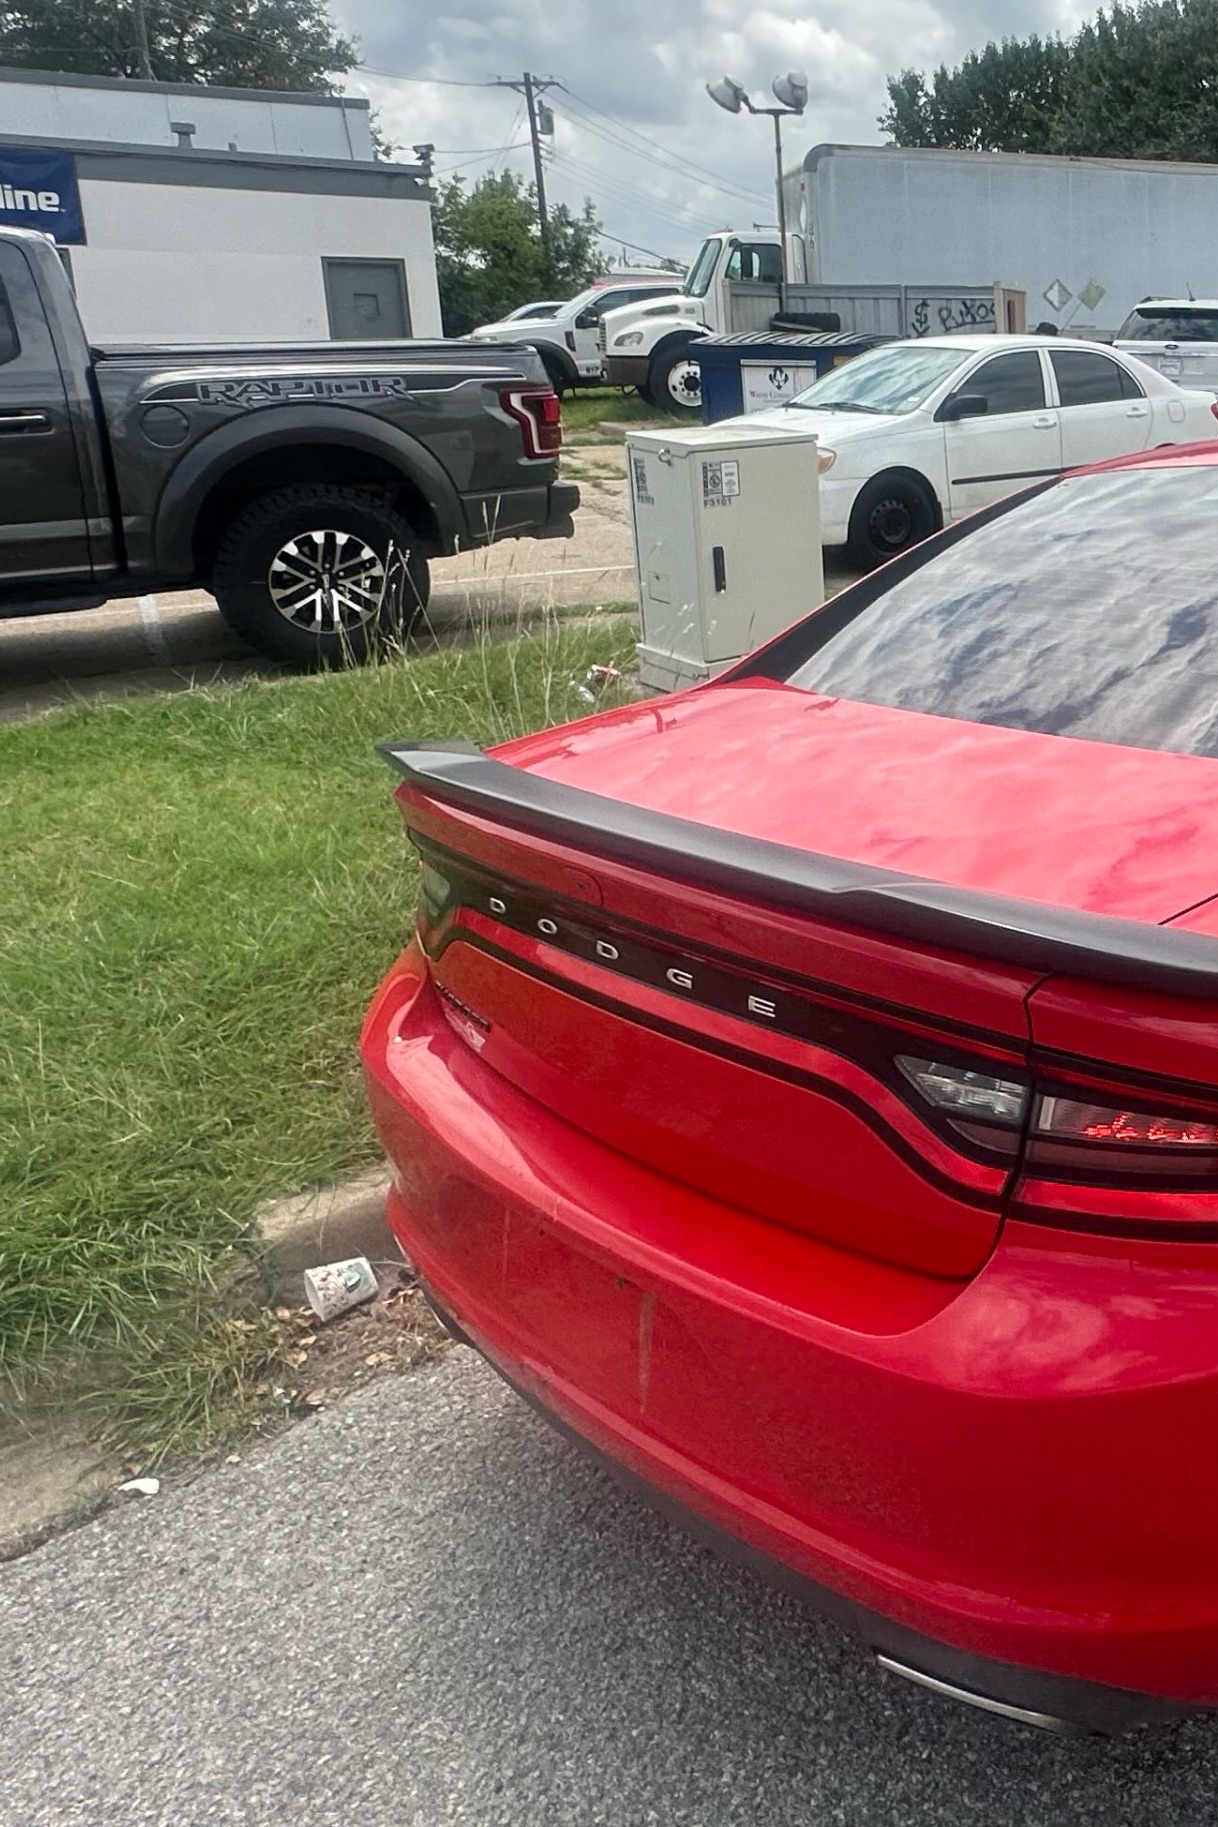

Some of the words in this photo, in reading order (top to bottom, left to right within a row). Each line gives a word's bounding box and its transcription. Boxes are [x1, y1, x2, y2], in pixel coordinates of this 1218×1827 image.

[195, 376, 417, 409] RAPTOR
[703, 497, 732, 509] F3101
[489, 897, 776, 1018] DODGE
